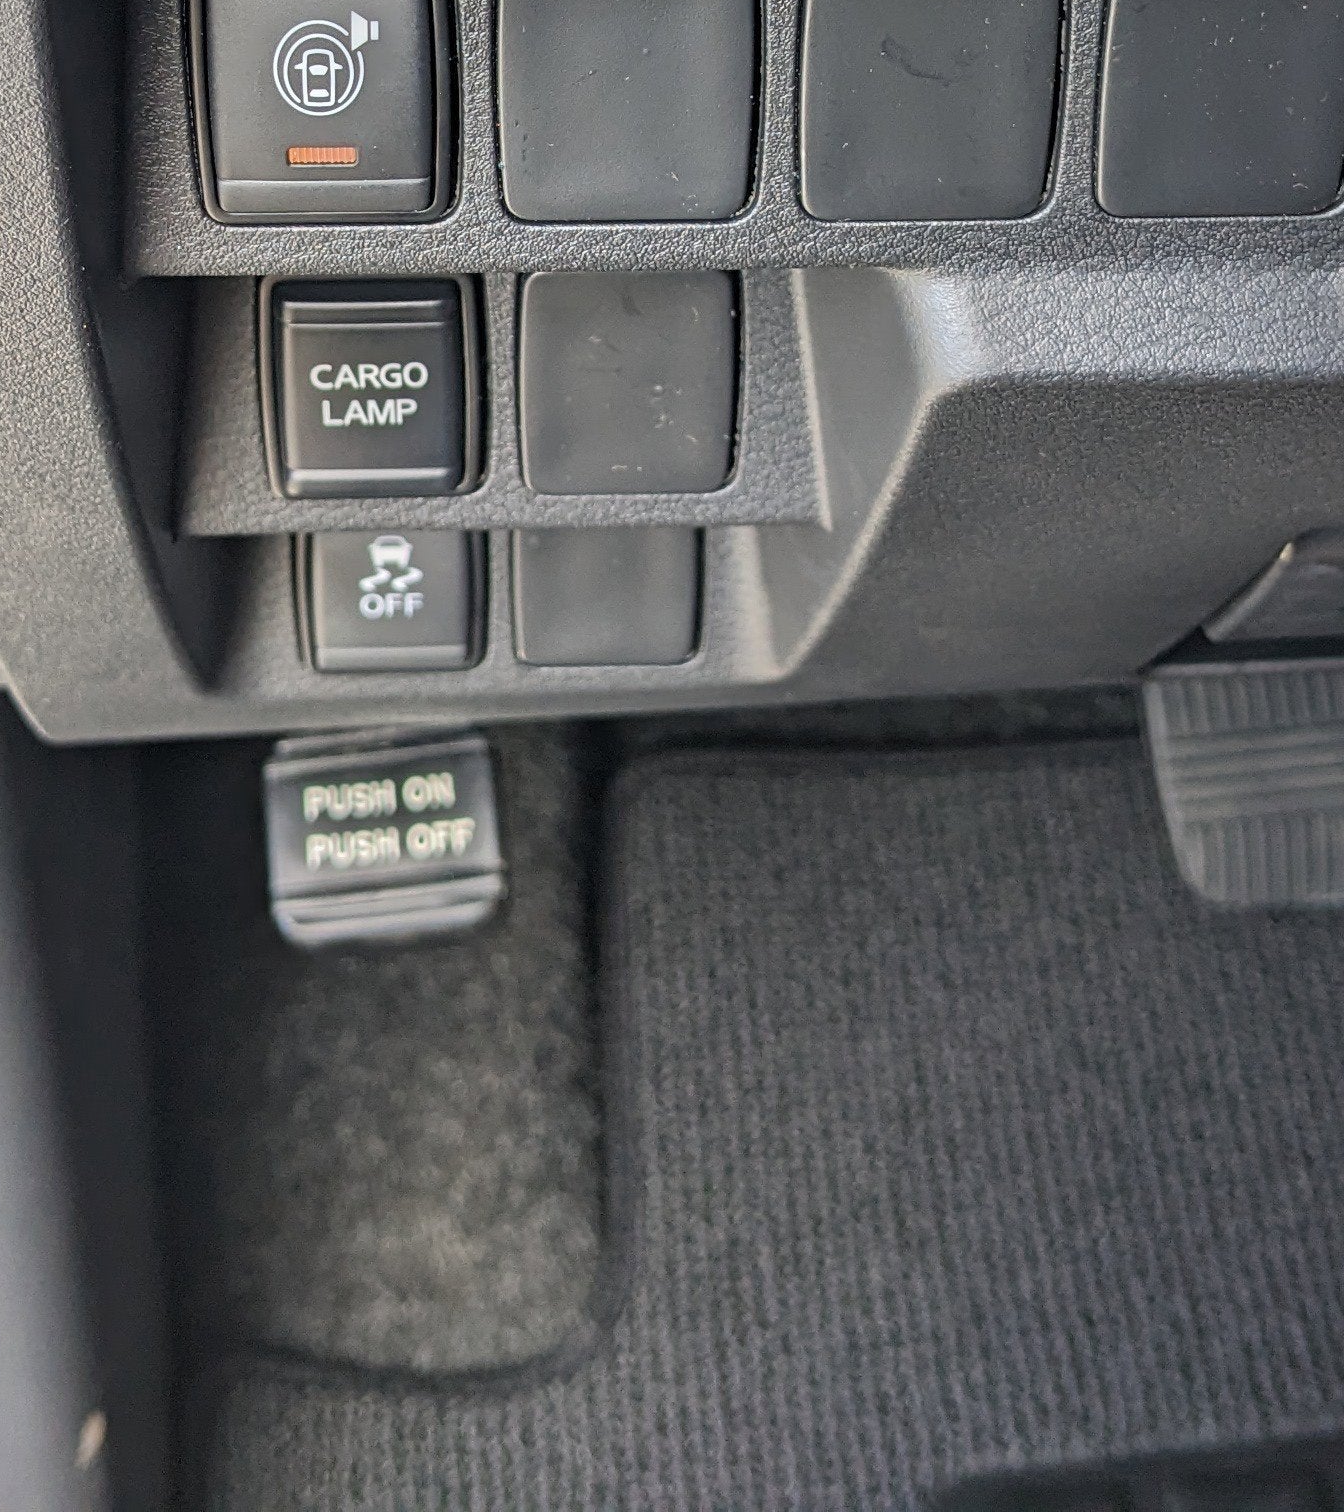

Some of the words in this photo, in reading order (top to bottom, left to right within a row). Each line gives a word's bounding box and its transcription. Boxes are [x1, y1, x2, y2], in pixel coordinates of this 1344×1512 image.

[308, 362, 430, 391] CARGO
[321, 397, 419, 428] LAMP
[359, 593, 425, 620] OFF
[303, 778, 397, 822] PUSH
[402, 772, 455, 812] ON
[306, 827, 400, 871] PUSH
[406, 818, 476, 860] OFF
